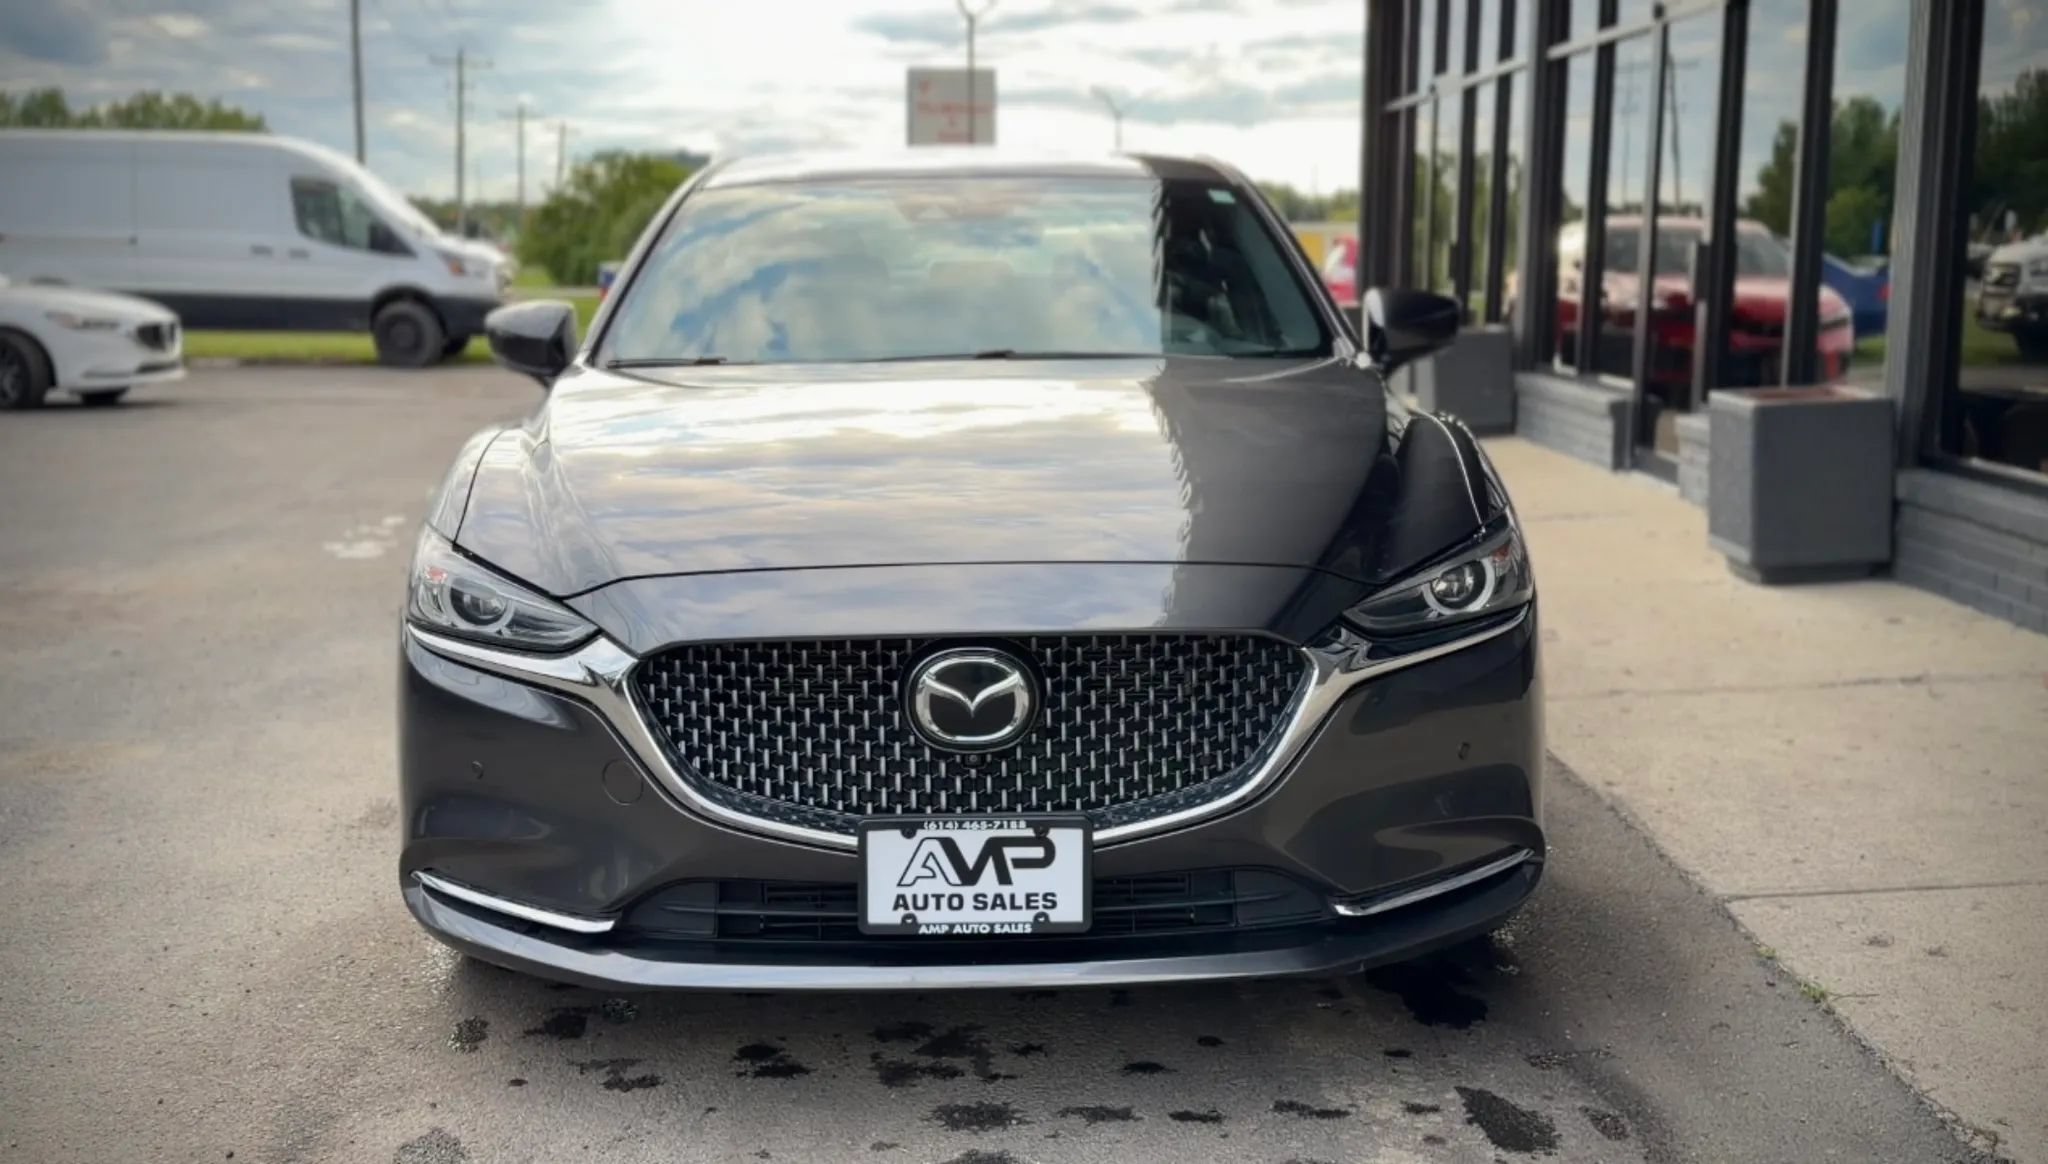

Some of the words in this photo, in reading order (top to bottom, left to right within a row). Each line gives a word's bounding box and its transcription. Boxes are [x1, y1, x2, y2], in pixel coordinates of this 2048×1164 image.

[923, 820, 959, 830] (614)
[897, 836, 1056, 887] AMP
[892, 893, 964, 911] AUTO
[973, 892, 1058, 911] SALES
[918, 923, 949, 934] AMP
[952, 923, 991, 934] AUTO
[993, 923, 1032, 934] SALES
